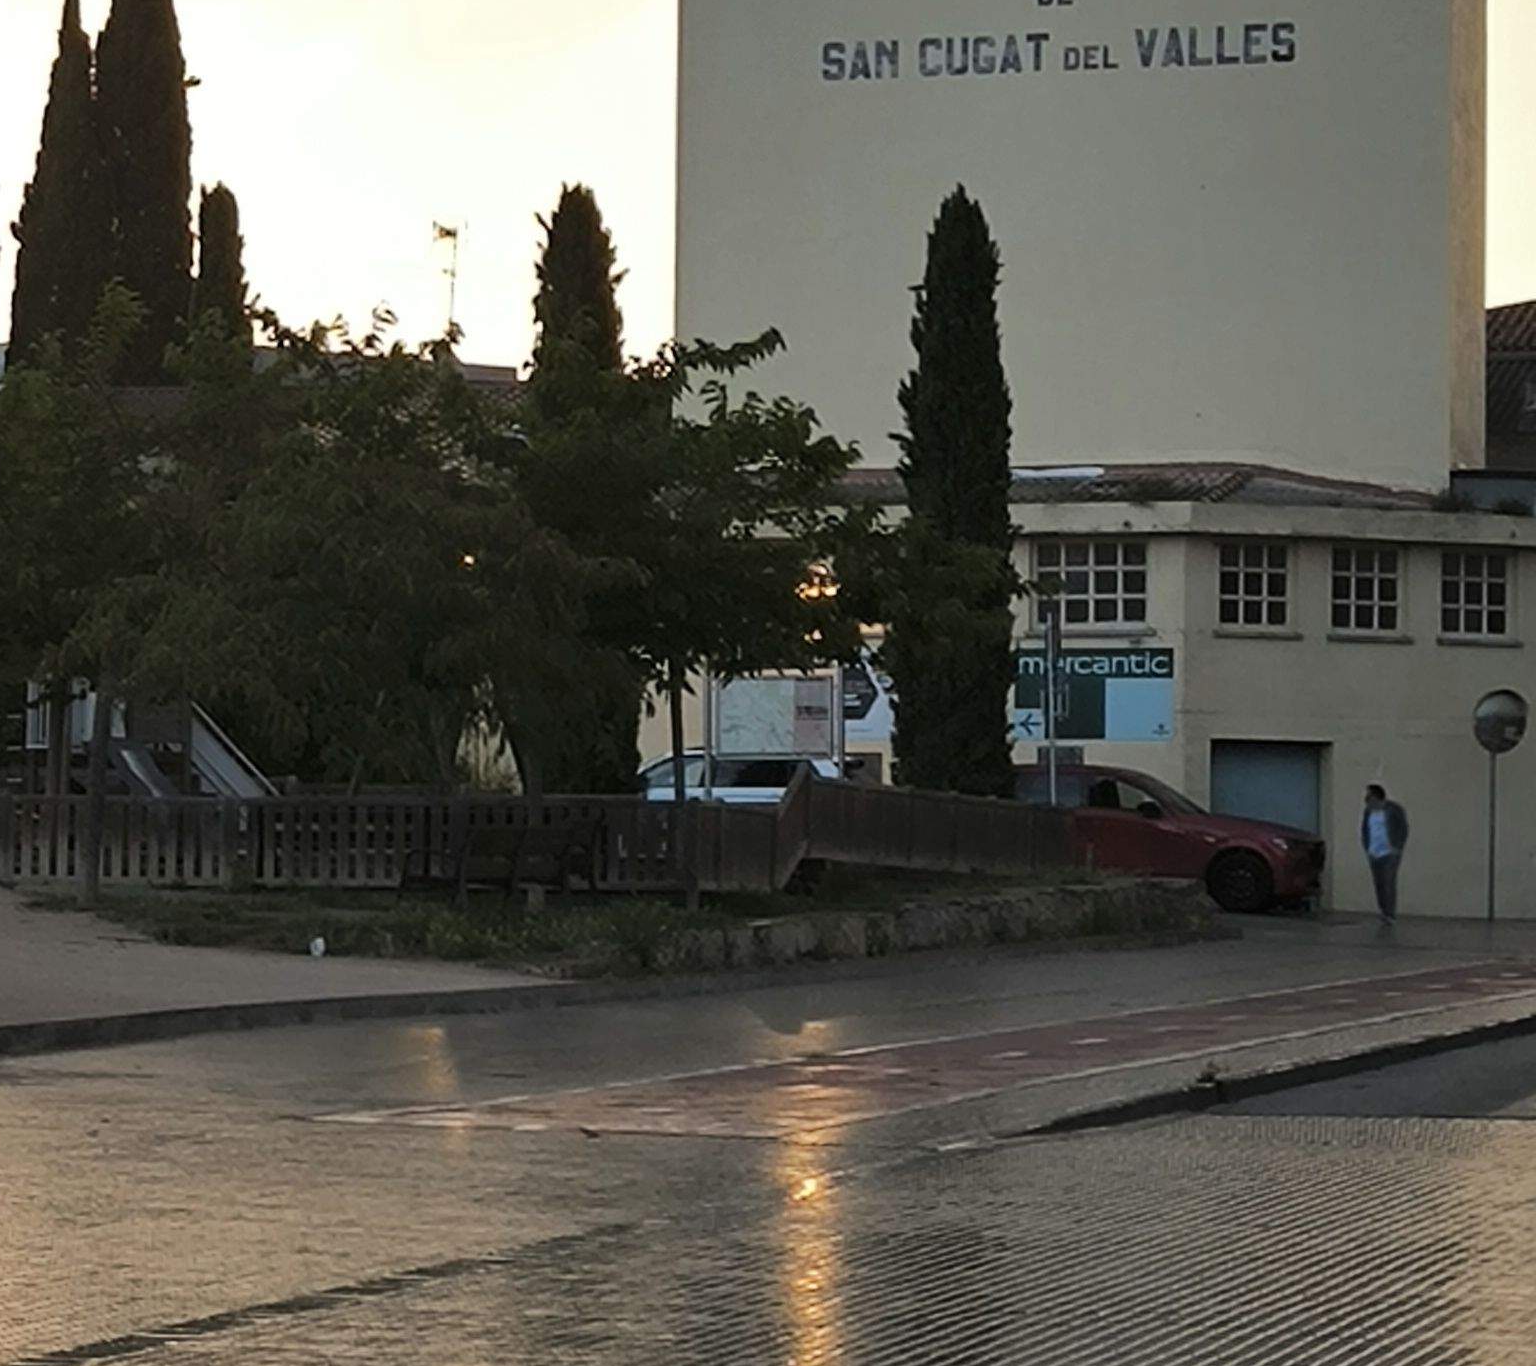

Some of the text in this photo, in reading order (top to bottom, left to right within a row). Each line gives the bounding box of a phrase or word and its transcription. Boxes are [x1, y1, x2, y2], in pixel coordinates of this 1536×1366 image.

[822, 22, 1295, 81] SAN CUGAT DEL VALLES
